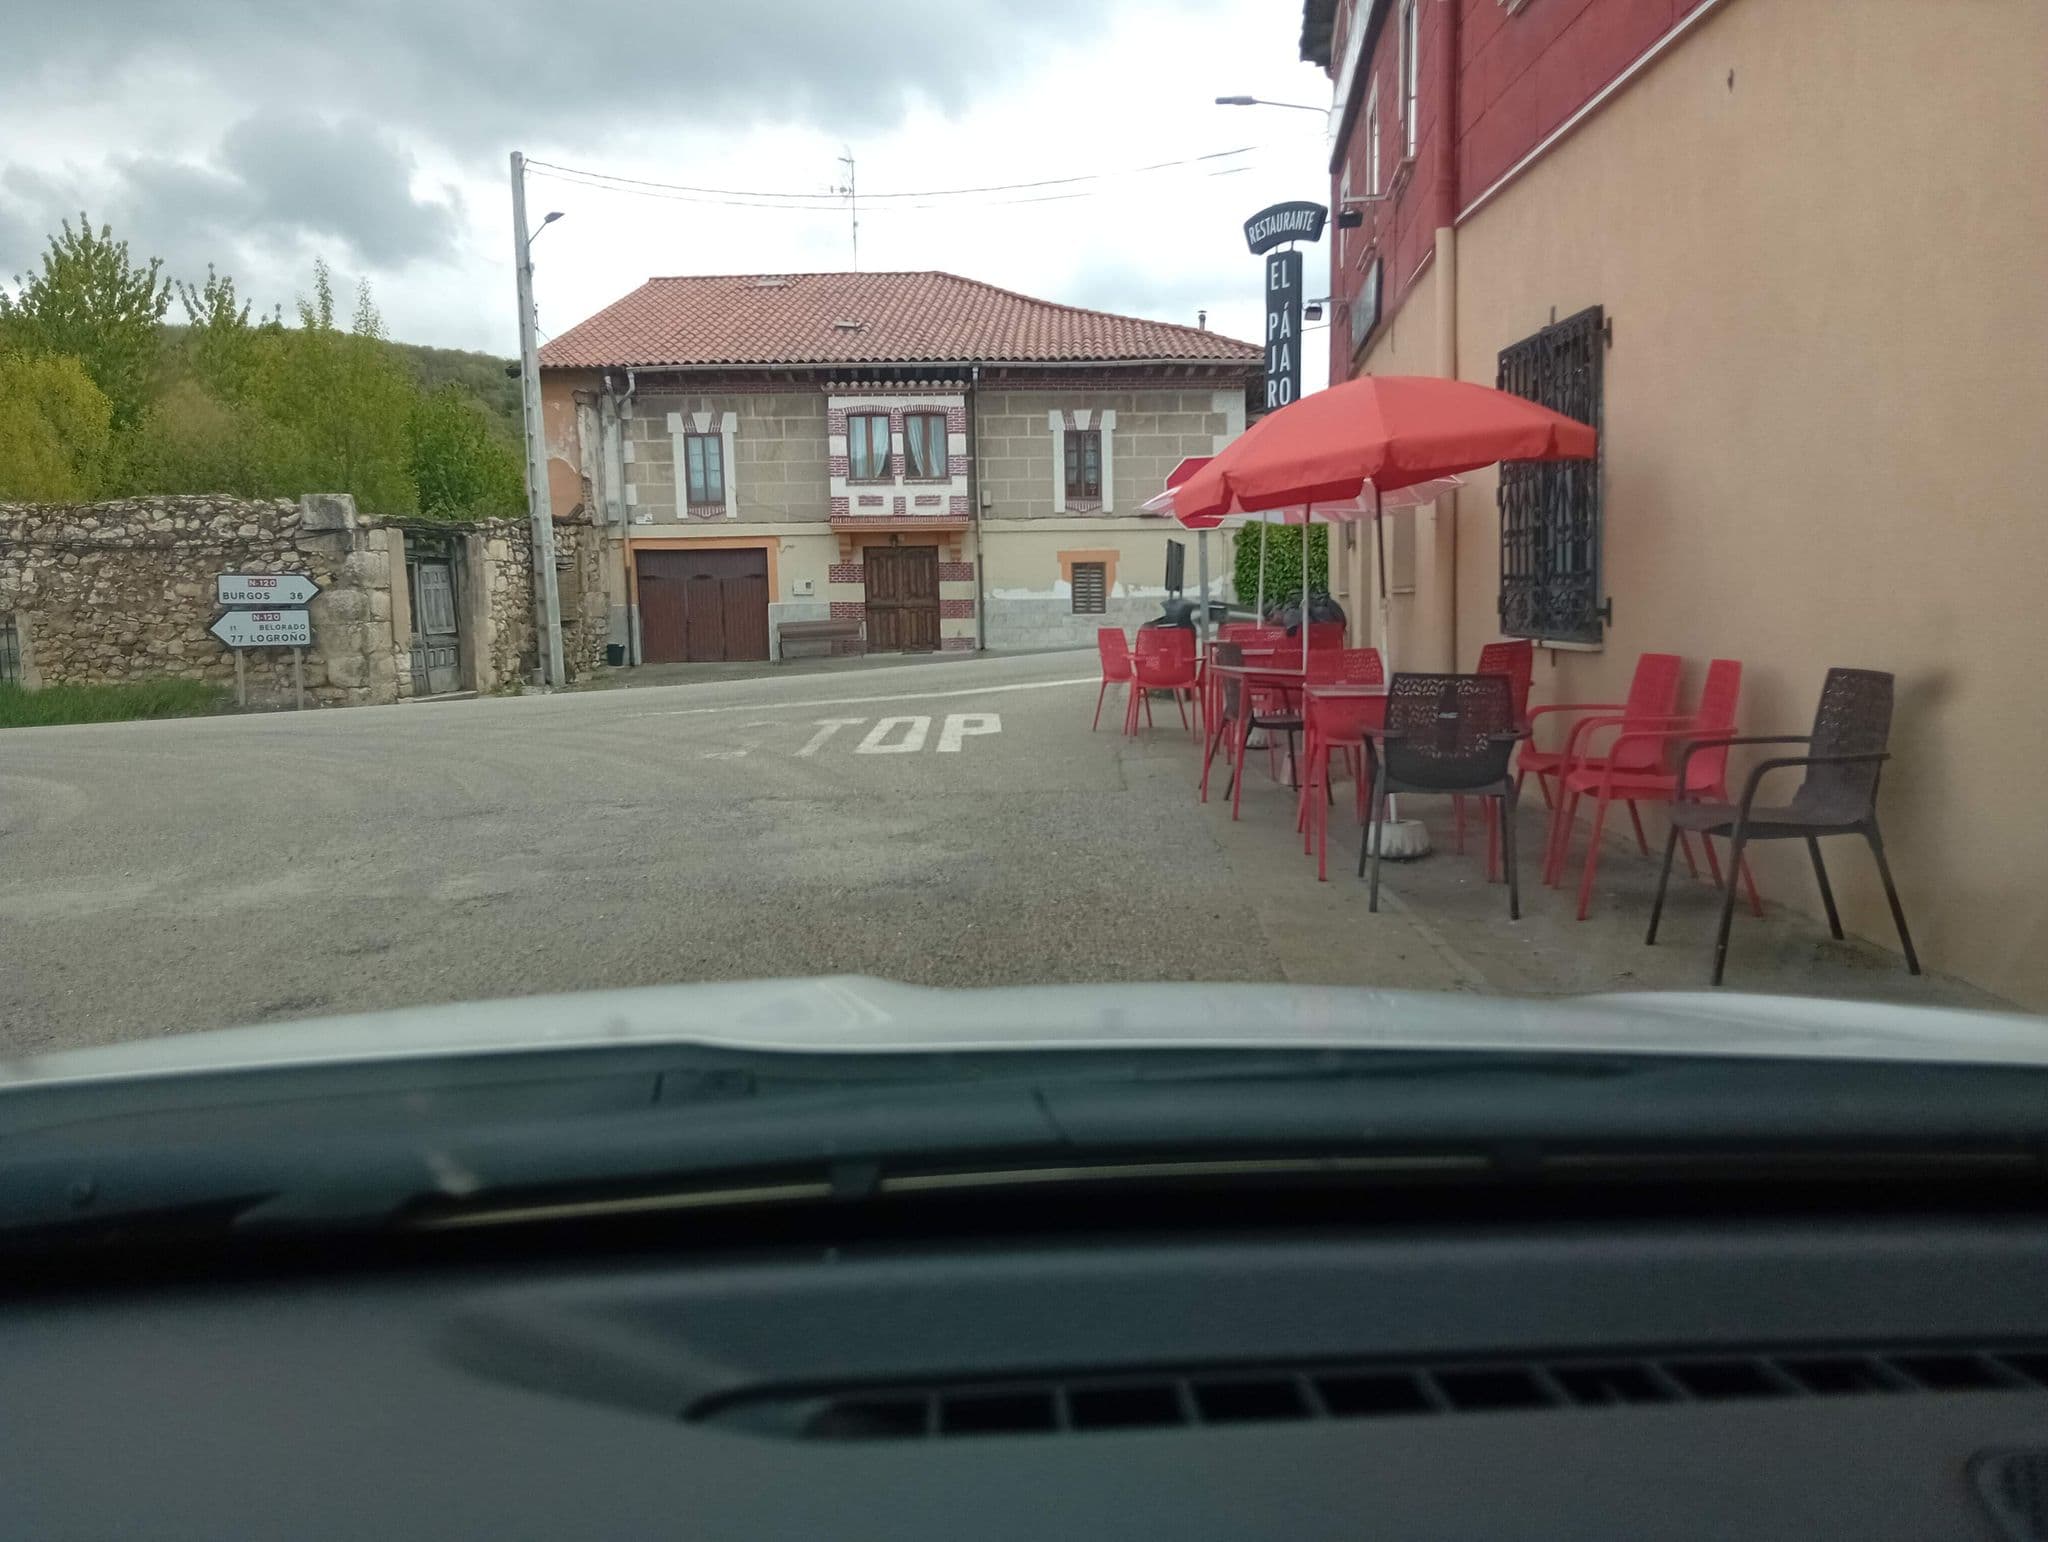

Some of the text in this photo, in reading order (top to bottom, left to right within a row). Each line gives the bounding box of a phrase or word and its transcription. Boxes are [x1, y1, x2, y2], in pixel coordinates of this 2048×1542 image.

[1248, 210, 1316, 245] RESTAURANTE
[1271, 260, 1290, 291] EL
[248, 579, 277, 587] N-120
[222, 592, 304, 600] BURGOS 36
[252, 613, 280, 621] N-120
[230, 631, 307, 643] 77 LOGROÑO
